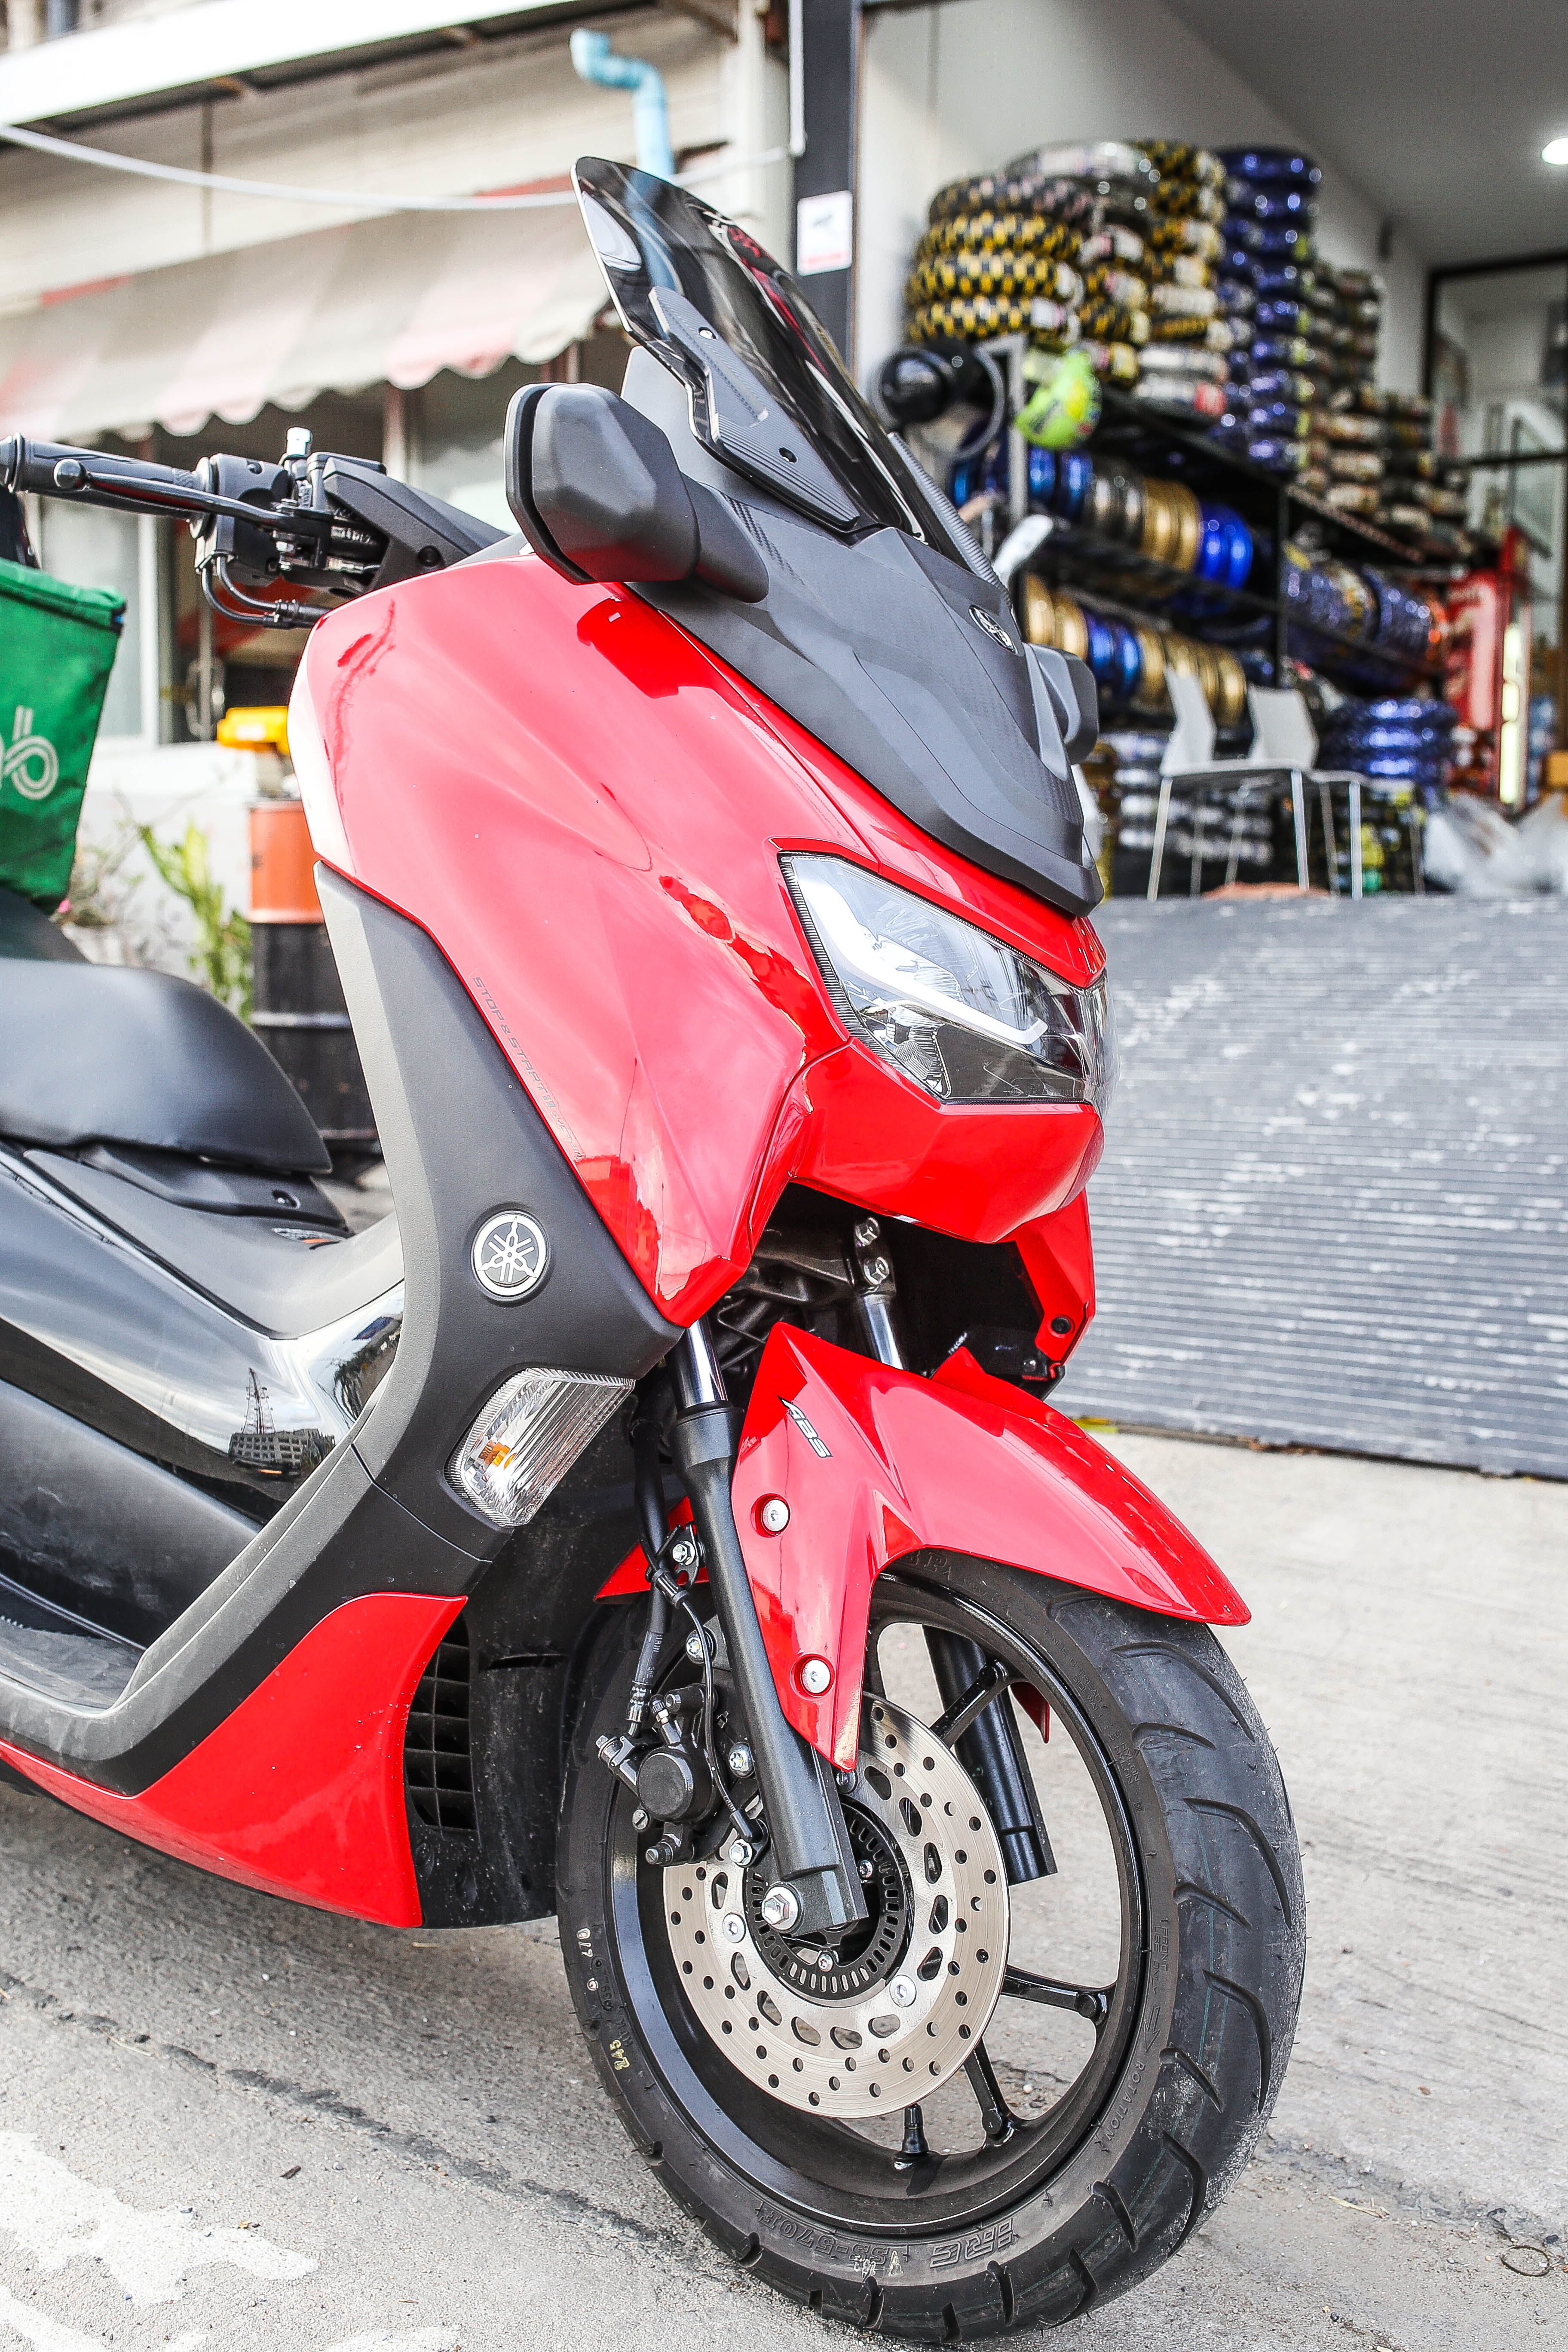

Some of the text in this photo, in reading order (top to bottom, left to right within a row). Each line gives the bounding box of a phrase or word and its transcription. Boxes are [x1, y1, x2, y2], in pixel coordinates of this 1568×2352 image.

[473, 977, 504, 1020] STOP
[501, 1024, 511, 1034] &
[508, 1037, 548, 1093] START
[777, 1394, 833, 1458] ABS
[1078, 1668, 1103, 1703] TREAD
[1121, 1742, 1141, 1782] NYLON
[1114, 1746, 1133, 1784] NYLON
[1105, 2060, 1146, 2141] ROTATION
[759, 2211, 890, 2265] SS-570F
